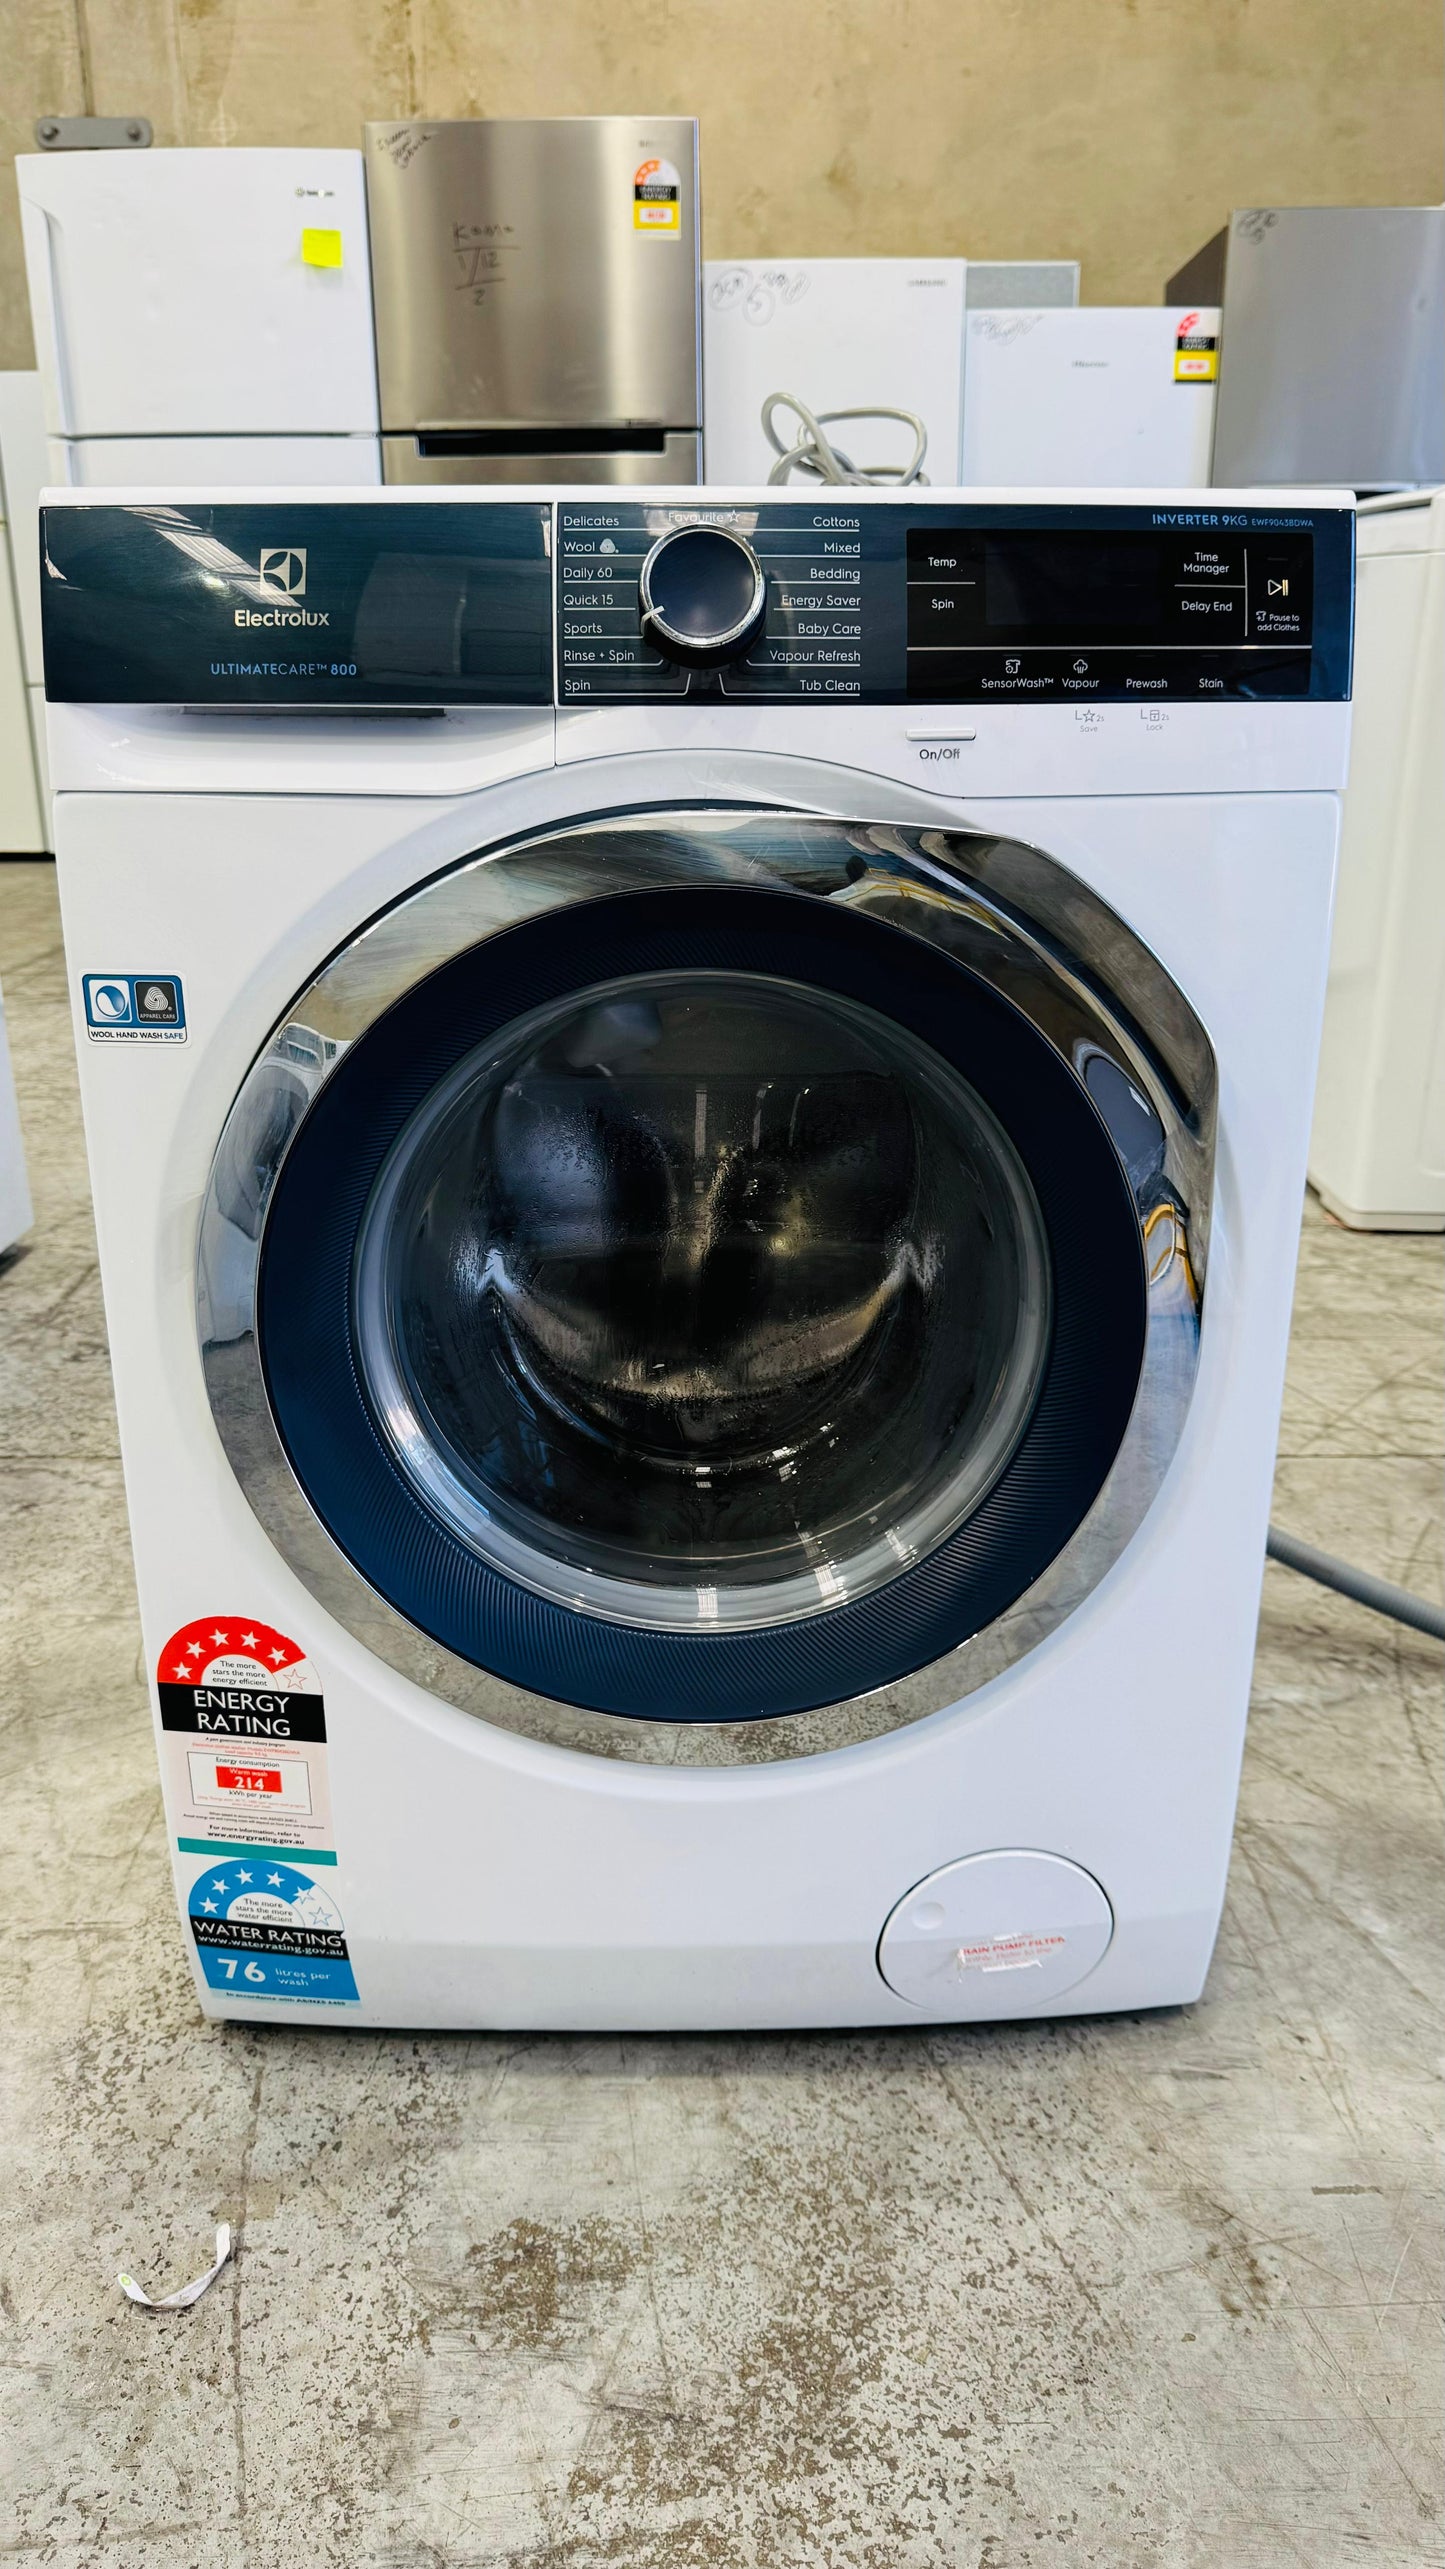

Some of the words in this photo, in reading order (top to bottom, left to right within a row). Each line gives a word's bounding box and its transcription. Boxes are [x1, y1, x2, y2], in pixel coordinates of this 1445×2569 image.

[563, 516, 620, 527] Delicates
[668, 511, 724, 523] Favourite
[813, 516, 860, 528] Cottons
[1152, 514, 1218, 526] INVERTER
[1222, 514, 1248, 526] 9KG
[563, 541, 595, 552] Wool
[824, 542, 861, 553] Mixed
[928, 556, 957, 568] Temp
[1194, 552, 1219, 562] Time
[563, 567, 594, 580] Daily
[597, 567, 613, 578] 60
[810, 568, 861, 582] Bedding
[1183, 563, 1229, 575] Manager
[563, 594, 598, 606] Quick
[601, 594, 614, 605] 15
[781, 594, 823, 608] Energy
[826, 594, 861, 606] Saver
[931, 598, 955, 610] Spin
[1181, 601, 1211, 613] Delay
[1213, 601, 1233, 612] End
[234, 609, 330, 627] Electrolux
[1269, 613, 1291, 622] Pause
[1291, 614, 1300, 622] to
[563, 622, 603, 634] Sports
[798, 623, 829, 637] Baby
[832, 623, 862, 634] Care
[1257, 623, 1272, 631] add
[1273, 623, 1300, 632] Clothes
[563, 650, 596, 661] Rinse
[608, 650, 635, 663] Spin
[769, 650, 814, 663] Vapour
[817, 650, 861, 662] Refresh
[210, 663, 327, 675] ULTIMATECARE™
[330, 664, 357, 676] 800
[564, 679, 591, 693] Spin
[800, 679, 822, 691] Tub
[824, 679, 861, 691] Clean
[1062, 678, 1100, 690] Vapour
[1126, 678, 1168, 689] Prewash
[1199, 678, 1224, 689] Stain
[1080, 724, 1098, 733] Save
[1146, 723, 1163, 731] Lock
[919, 748, 960, 761] On/Off
[116, 1031, 138, 1039] HAND
[140, 1031, 163, 1040] WASH
[163, 1032, 184, 1040] SAFE
[220, 1660, 235, 1668] The
[212, 1677, 237, 1685] energy
[238, 1678, 268, 1687] efficient
[193, 1689, 290, 1714] ENERGY
[197, 1712, 291, 1736] RATING
[215, 1756, 237, 1765] Energy
[239, 1760, 280, 1768] consumption
[234, 1776, 265, 1790] 214
[207, 1832, 305, 1845] www.energyrating.gov.au
[244, 1897, 259, 1906] The
[261, 1901, 283, 1909] more
[235, 1905, 254, 1913] stars
[256, 1906, 270, 1914] the
[272, 1909, 293, 1917] more
[237, 1912, 259, 1920] water
[262, 1914, 293, 1923] efficient
[194, 1920, 263, 1940] WATER
[268, 1929, 342, 1947] RATING
[198, 1935, 344, 1956] www.waterrating.gov.au
[992, 1941, 1025, 1952] PUMP
[217, 1958, 266, 1983] 76
[275, 1967, 306, 1978] litres
[310, 1972, 331, 1981] per
[278, 1978, 309, 1986] wash
